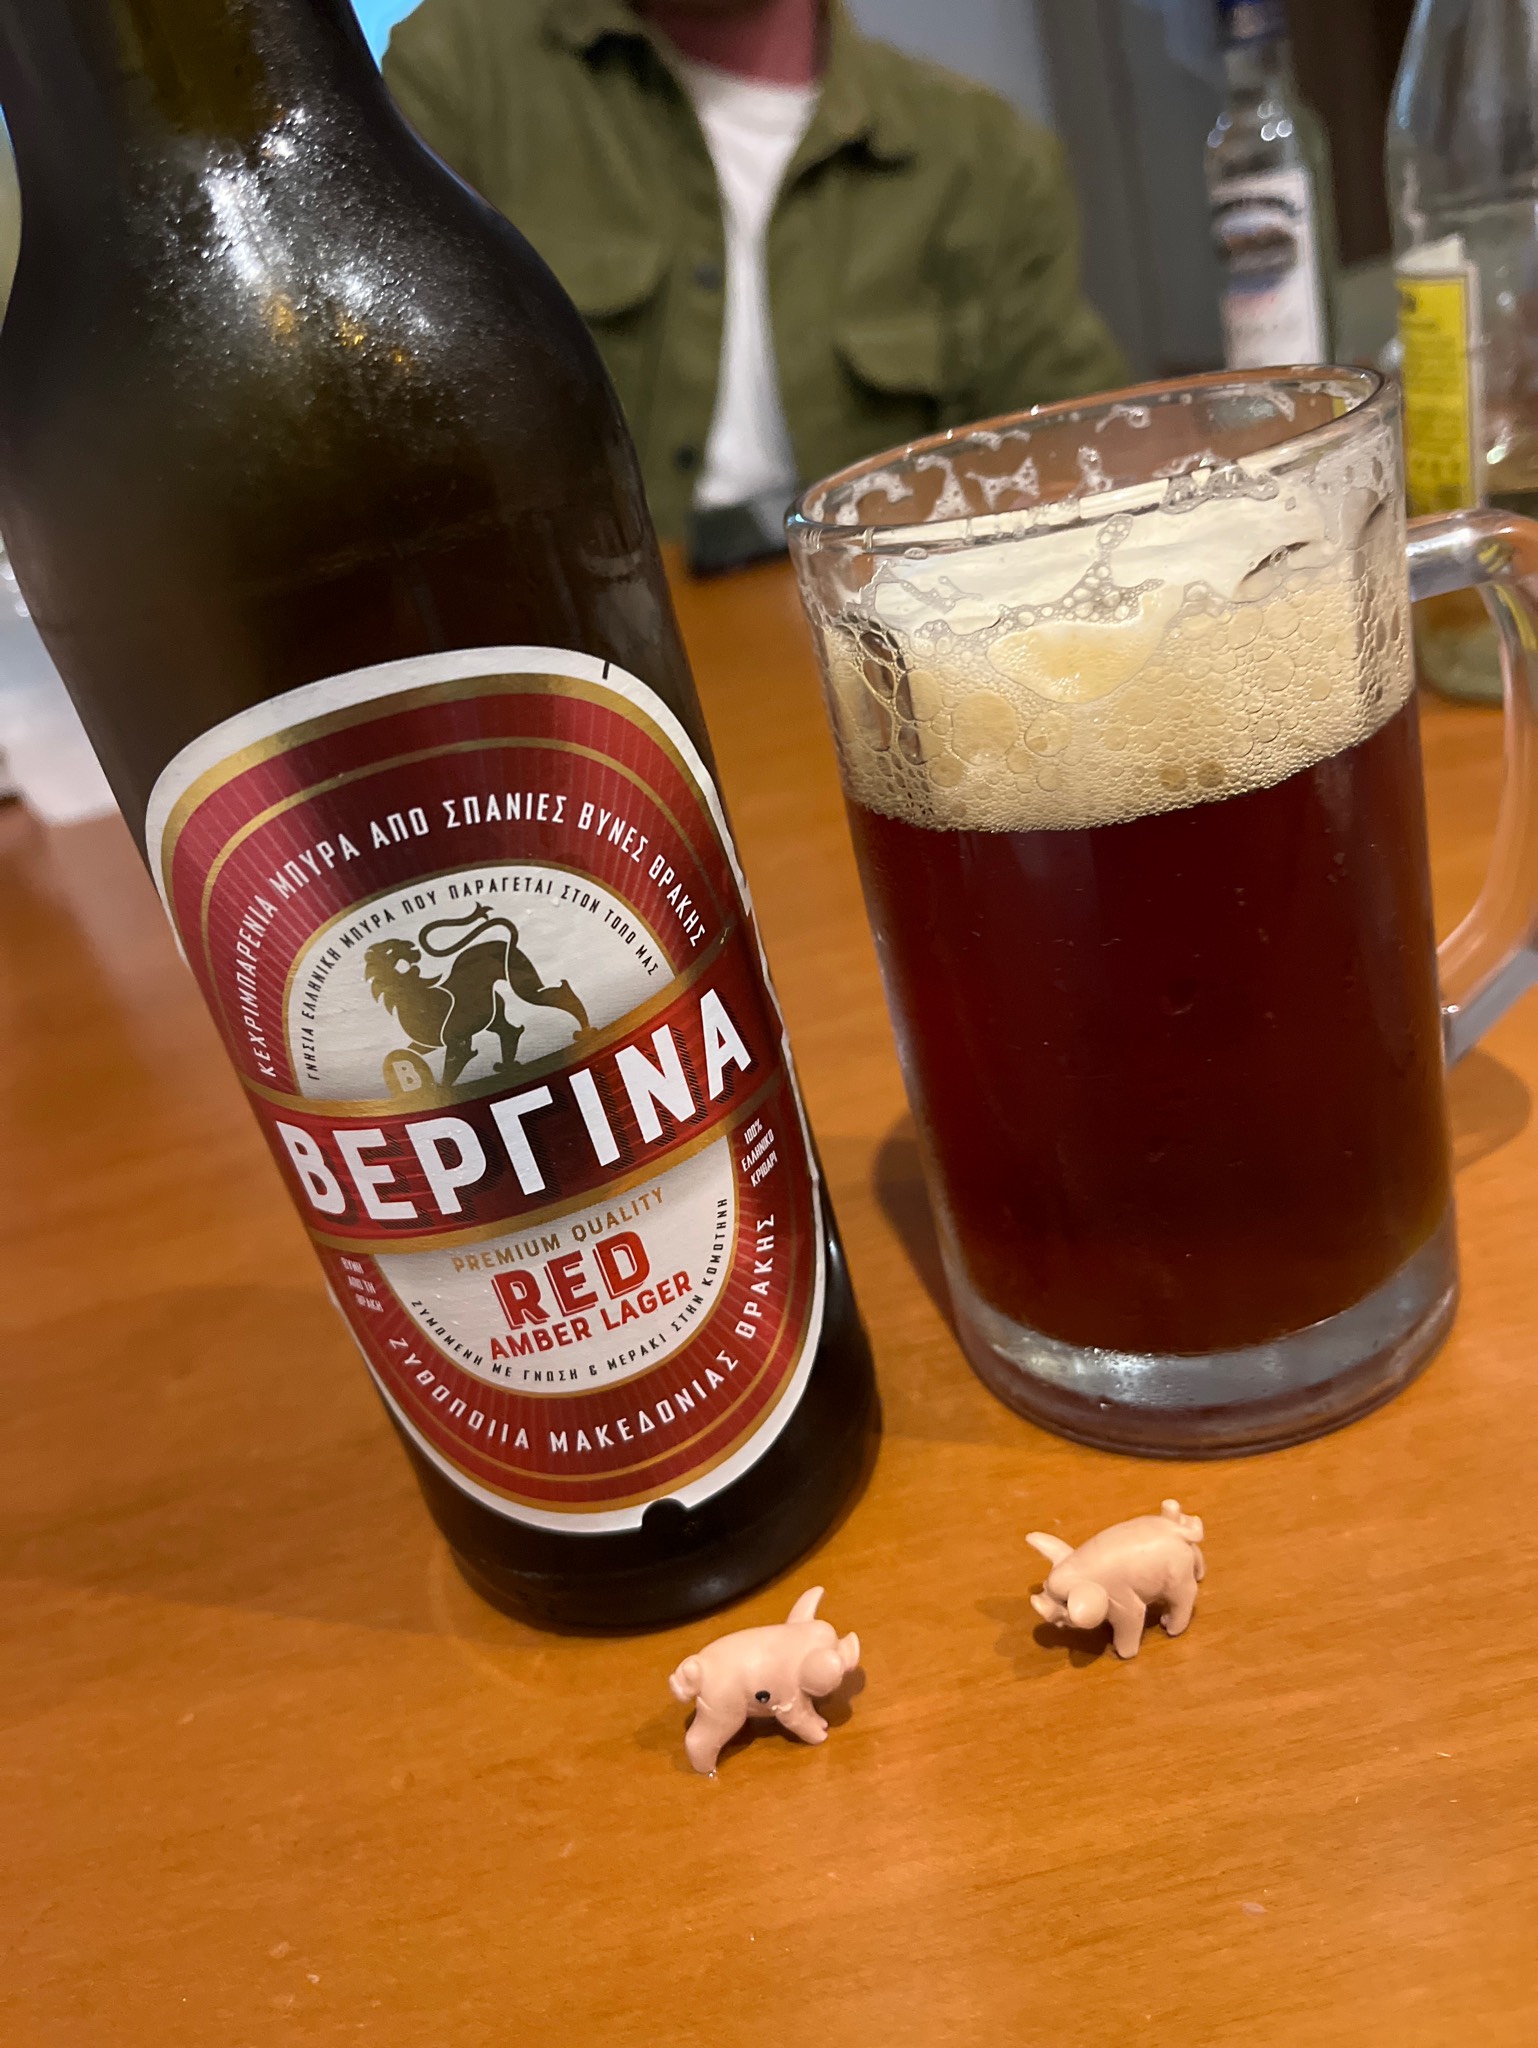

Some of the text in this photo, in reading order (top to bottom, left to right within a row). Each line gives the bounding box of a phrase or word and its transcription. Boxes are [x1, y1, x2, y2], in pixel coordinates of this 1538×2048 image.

[236, 793, 706, 1077] ΚΕΧΡΙΜΠΑΡΕΝΙΑ ΜΠΥΡΑ ΑΠΟ ΣΠΑΝΙΕΣ ΒΥΝΕΣ ΘΡΑΚΗΣ
[301, 877, 659, 1080] ΓΝΗΣΙΑ ΕΛΛΗΝΙΚΗ ΜΠΥΡΑ ΠΟΥ ΠΑΡΑΓΕΤΑΙ ΣΤΟΝ ΤΟΠΟ ΜΑΣ
[276, 988, 754, 1222] ΒΕΡΓΙΝΑ
[744, 1118, 763, 1144] 100%
[411, 1300, 484, 1366] ΖΥΜΩΜΕΝΗ
[492, 1363, 513, 1377] ΜΕ
[523, 1368, 578, 1382] ΓΝΩΣΗ
[606, 1333, 667, 1371] ΜΕΡΑΚΙ
[671, 1293, 704, 1332] ΣΤΗΝ
[701, 1198, 728, 1286] ΚΟΜΟΤΗΝΗ
[452, 1186, 664, 1273] PREMIUM QUALITY
[489, 1270, 693, 1361] AMBER LAGER
[490, 1230, 651, 1331] RED
[388, 1213, 775, 1452] ΖΥΘΟΠΟΙΙΑ ΜΑΚΕΔΟΝΙΑΣ ΘΡΑΚΗΣ
